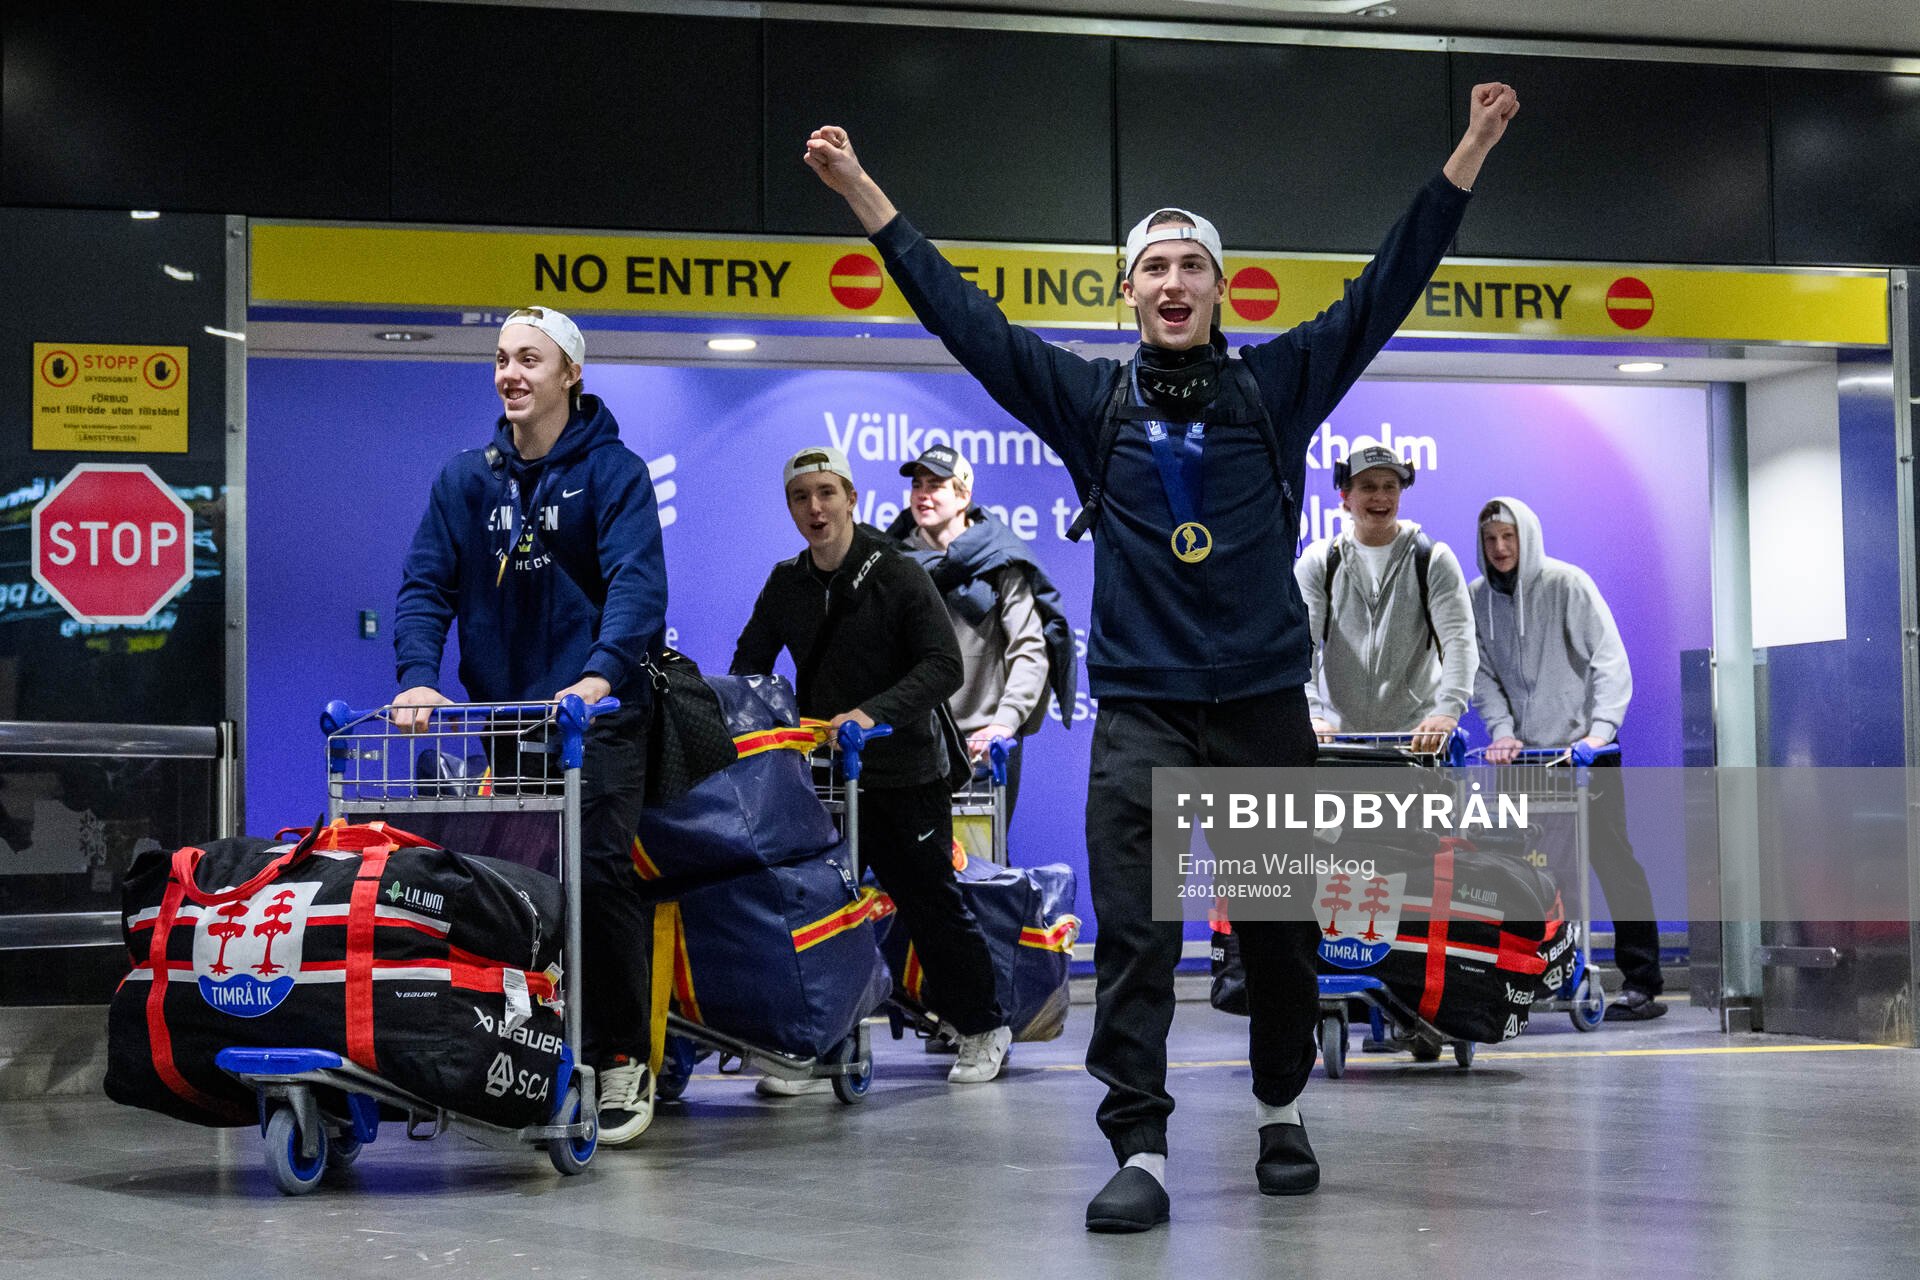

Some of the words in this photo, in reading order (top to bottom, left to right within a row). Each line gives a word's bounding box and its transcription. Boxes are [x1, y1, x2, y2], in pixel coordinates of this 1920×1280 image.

[535, 254, 608, 294] NO
[626, 258, 791, 298] ENTRY
[1425, 281, 1571, 320] ENTRY
[83, 355, 139, 369] STOPP
[91, 392, 129, 403] FÖRBUD
[41, 406, 60, 414] mot
[111, 407, 134, 415] utan
[48, 521, 178, 566] STOP
[404, 886, 444, 911] LILIUM
[1324, 943, 1359, 961] TIMRÅ
[1360, 949, 1373, 962] IK
[211, 981, 255, 1006] TIMRÅ
[257, 986, 273, 1006] IK
[515, 1069, 550, 1102] SCA
